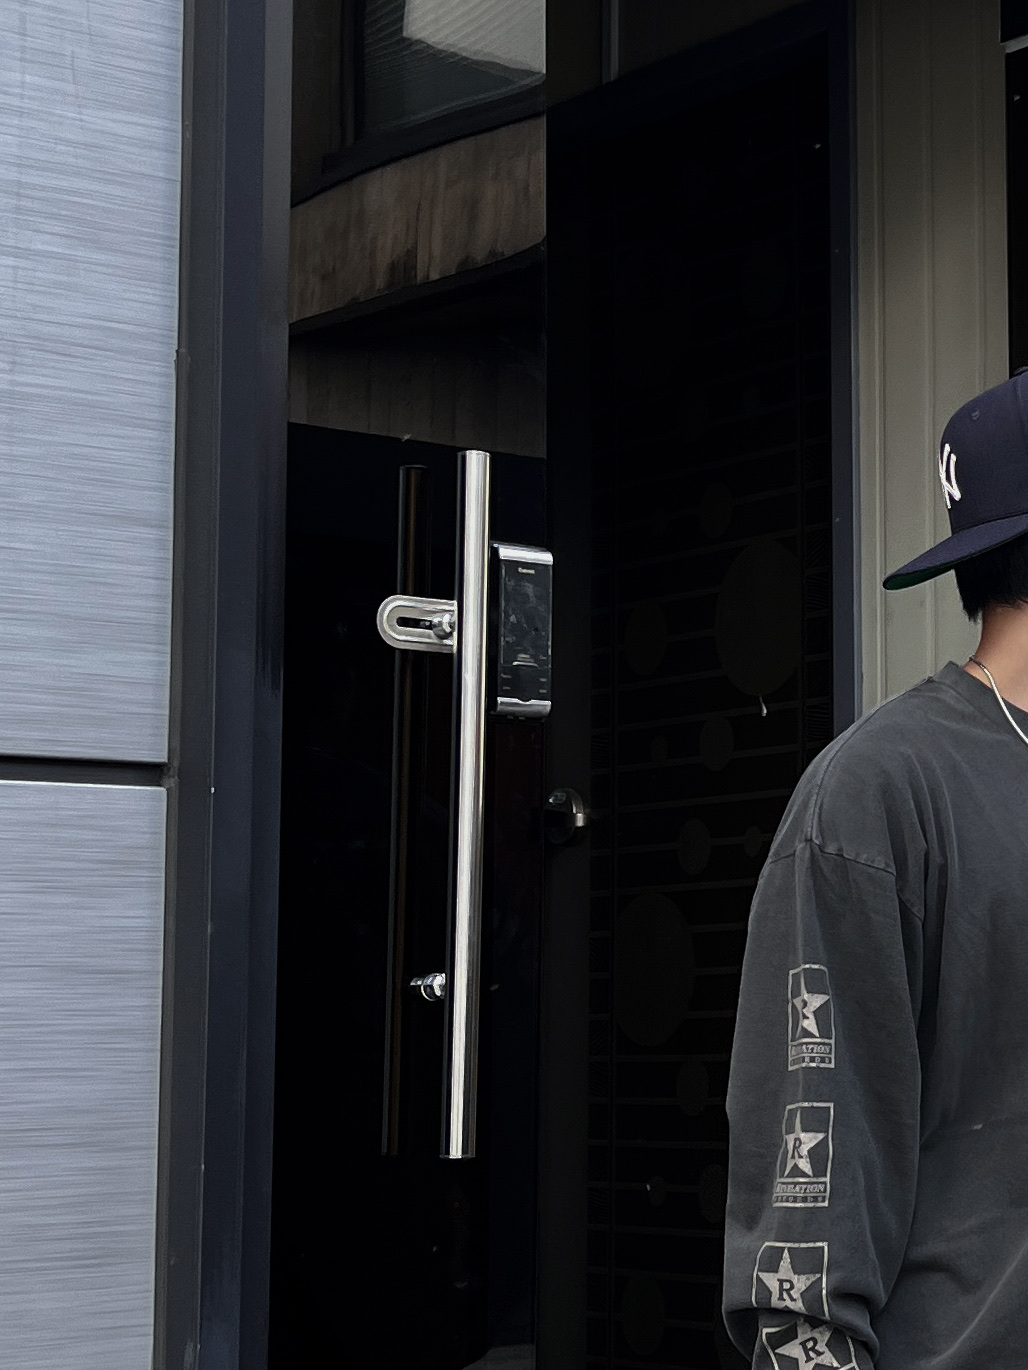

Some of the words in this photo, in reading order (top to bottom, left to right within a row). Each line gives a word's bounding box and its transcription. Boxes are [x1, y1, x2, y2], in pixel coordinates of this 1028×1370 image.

[790, 1137, 804, 1160] R
[776, 1278, 797, 1302] R
[799, 1336, 826, 1364] R
